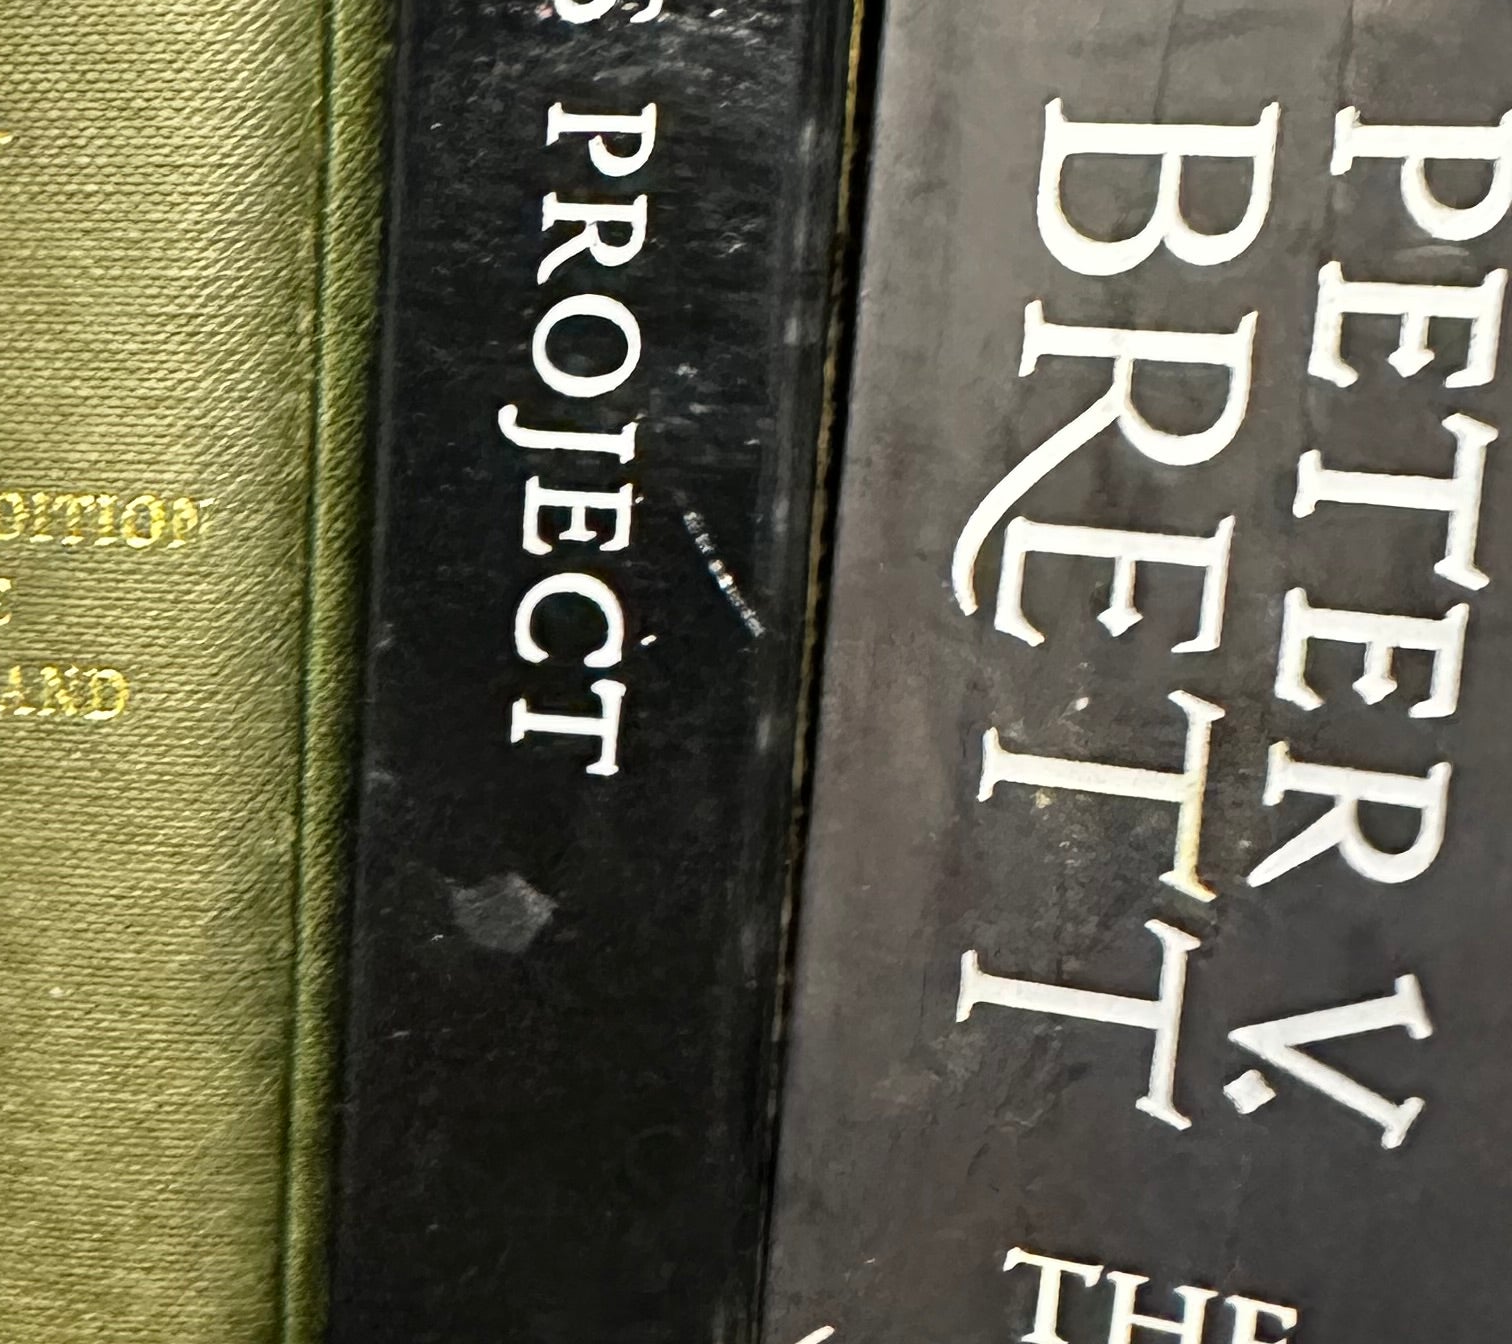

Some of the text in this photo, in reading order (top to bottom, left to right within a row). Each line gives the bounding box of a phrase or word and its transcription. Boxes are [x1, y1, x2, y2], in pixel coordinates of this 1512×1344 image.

[497, 101, 657, 777] PROJECT
[951, 96, 1282, 1131] BRETT
[1222, 105, 1512, 1149] PETER V.
